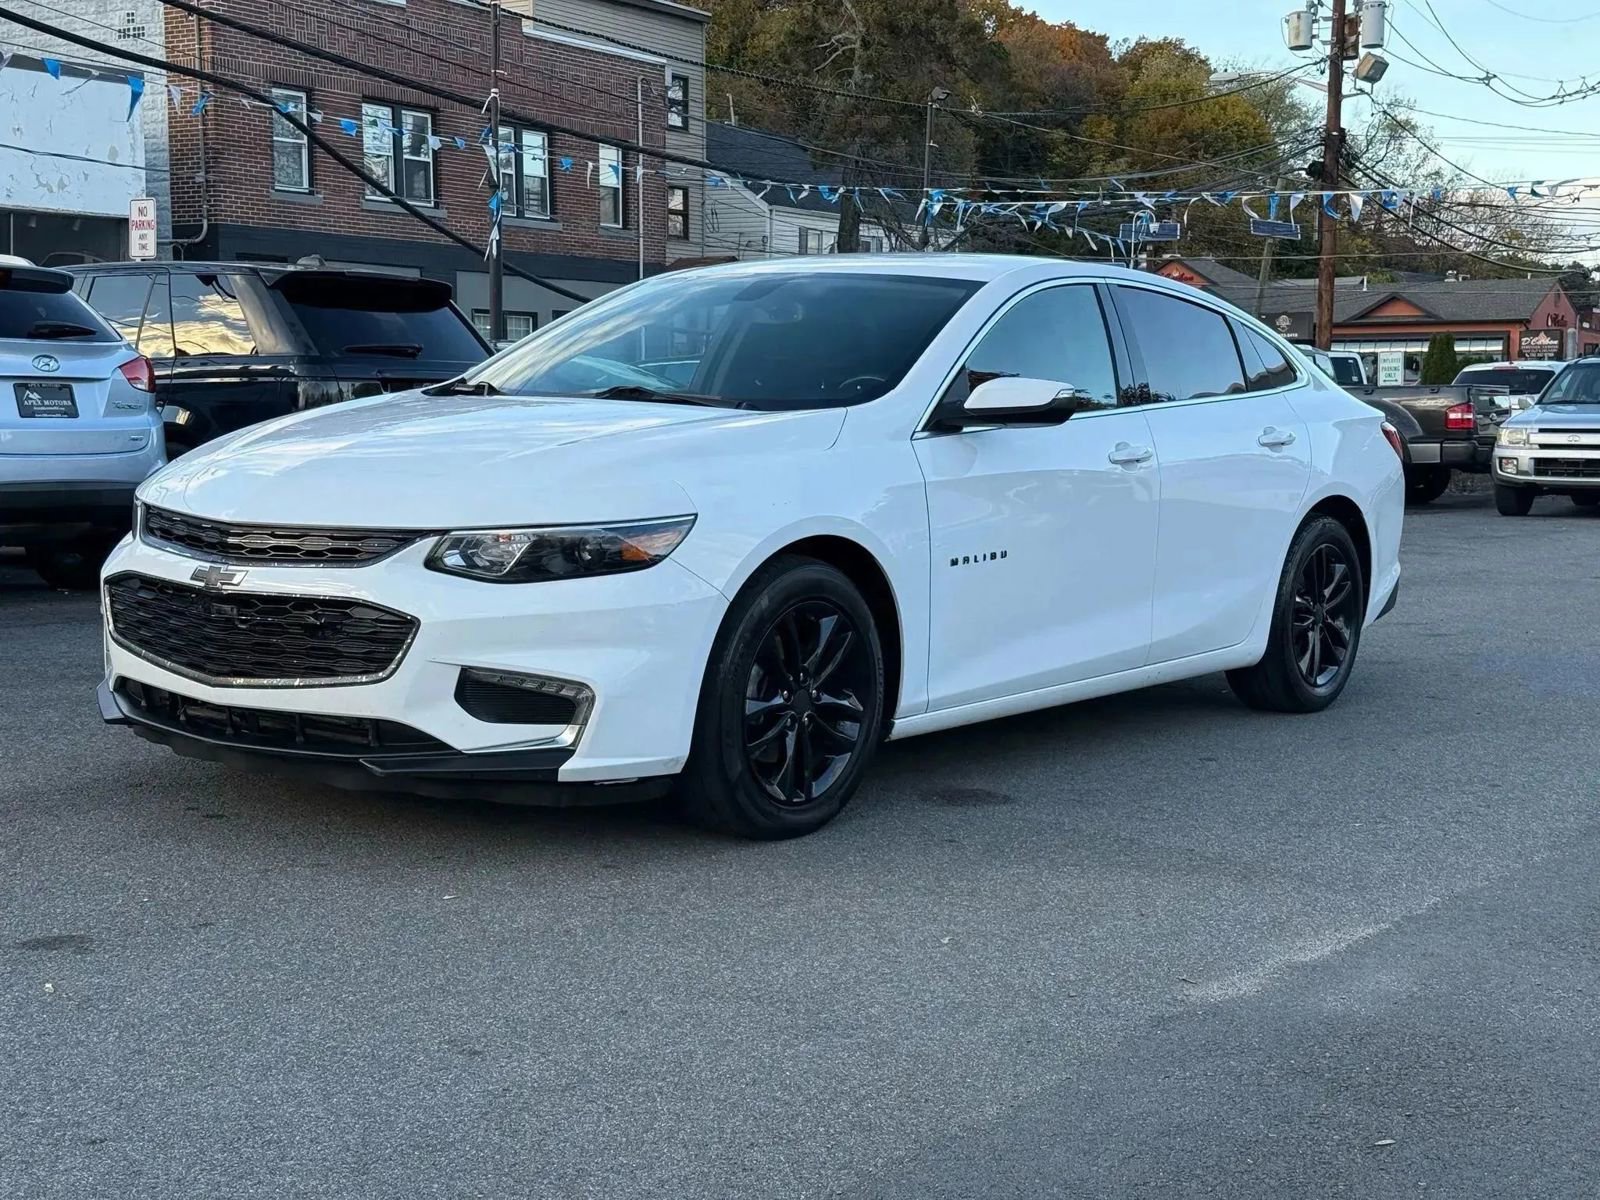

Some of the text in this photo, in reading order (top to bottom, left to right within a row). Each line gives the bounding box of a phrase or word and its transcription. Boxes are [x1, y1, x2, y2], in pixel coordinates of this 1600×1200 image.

[138, 206, 148, 217] NO
[131, 219, 155, 231] PARKING
[139, 233, 148, 241] ANY
[138, 242, 149, 251] TIME
[950, 550, 1008, 567] MALIBU
